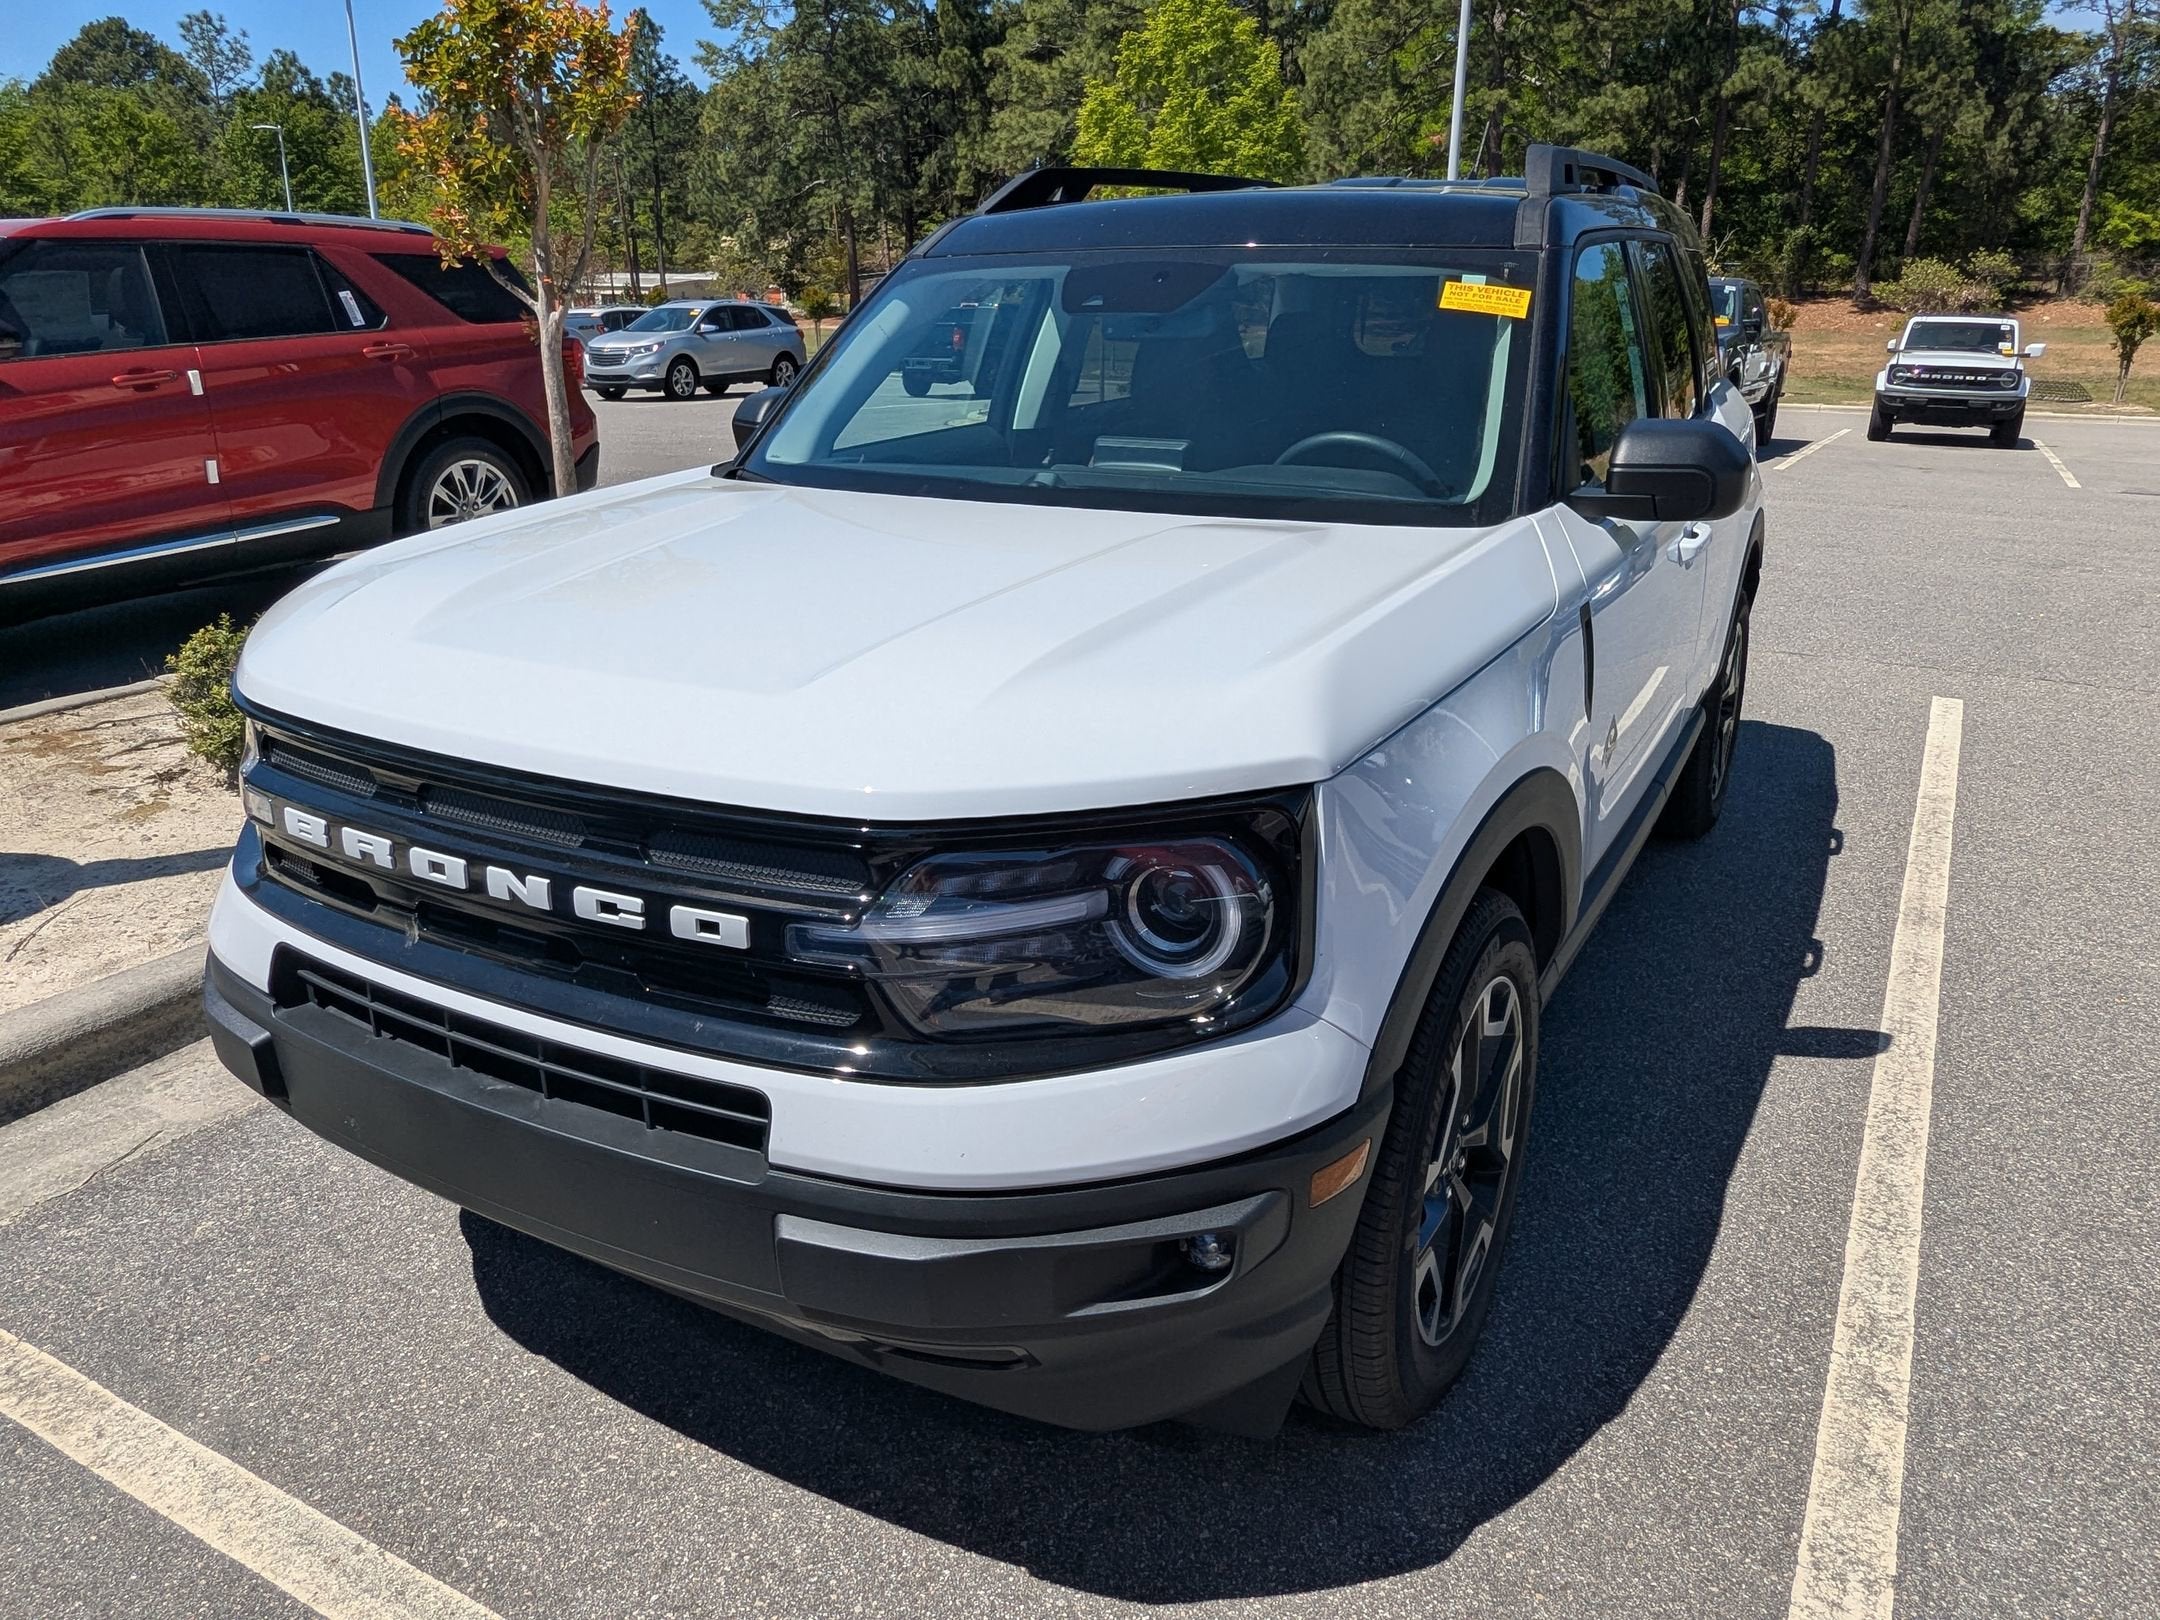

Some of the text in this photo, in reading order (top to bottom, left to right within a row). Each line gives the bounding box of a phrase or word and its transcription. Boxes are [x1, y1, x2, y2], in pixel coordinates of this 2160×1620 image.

[1449, 283, 1525, 299] THIS VEHICLE
[1449, 290, 1469, 298] NOT
[1496, 296, 1521, 304] SALE
[1920, 373, 1987, 381] BRONCO
[283, 806, 751, 949] BRONCO
